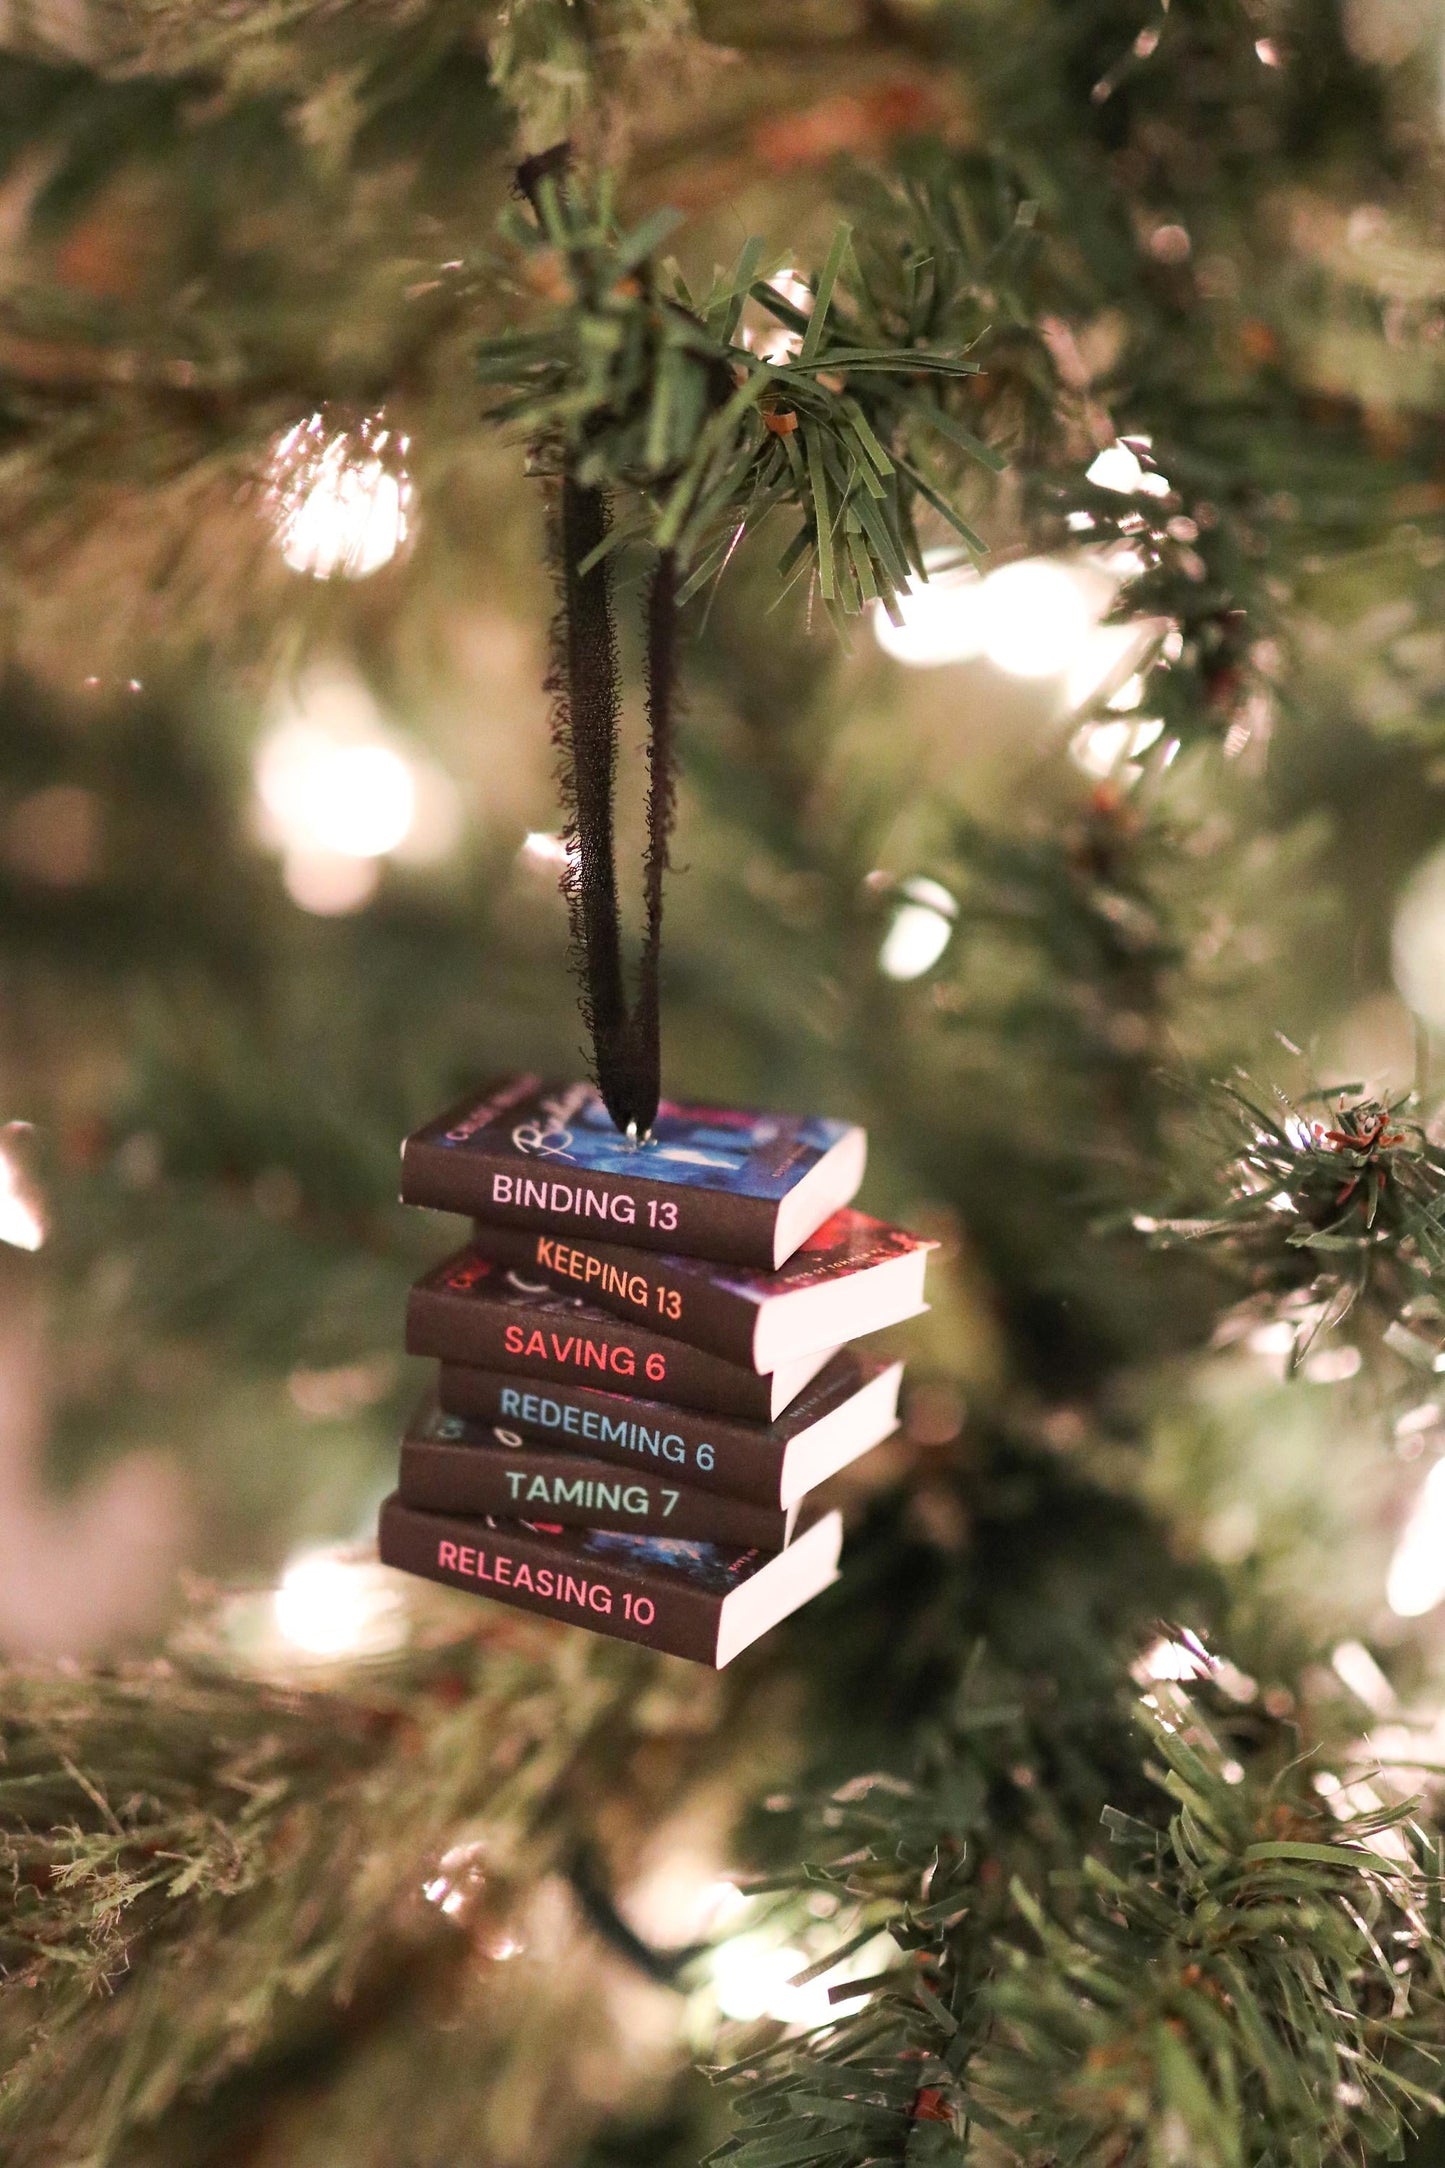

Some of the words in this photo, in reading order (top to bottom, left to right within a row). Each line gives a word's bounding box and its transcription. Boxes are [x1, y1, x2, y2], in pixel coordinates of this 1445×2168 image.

[492, 1174, 636, 1224] BINDING
[647, 1200, 678, 1231] 13
[536, 1236, 648, 1308] KEEPING
[656, 1286, 683, 1320] 13
[504, 1325, 636, 1377] SAVING
[645, 1353, 667, 1382] 6
[500, 1388, 685, 1464] REDEEMING
[695, 1443, 716, 1471] 6
[505, 1471, 650, 1515] TAMING
[659, 1489, 680, 1518] 7
[438, 1540, 612, 1615] RELEASING
[622, 1592, 656, 1626] 10
